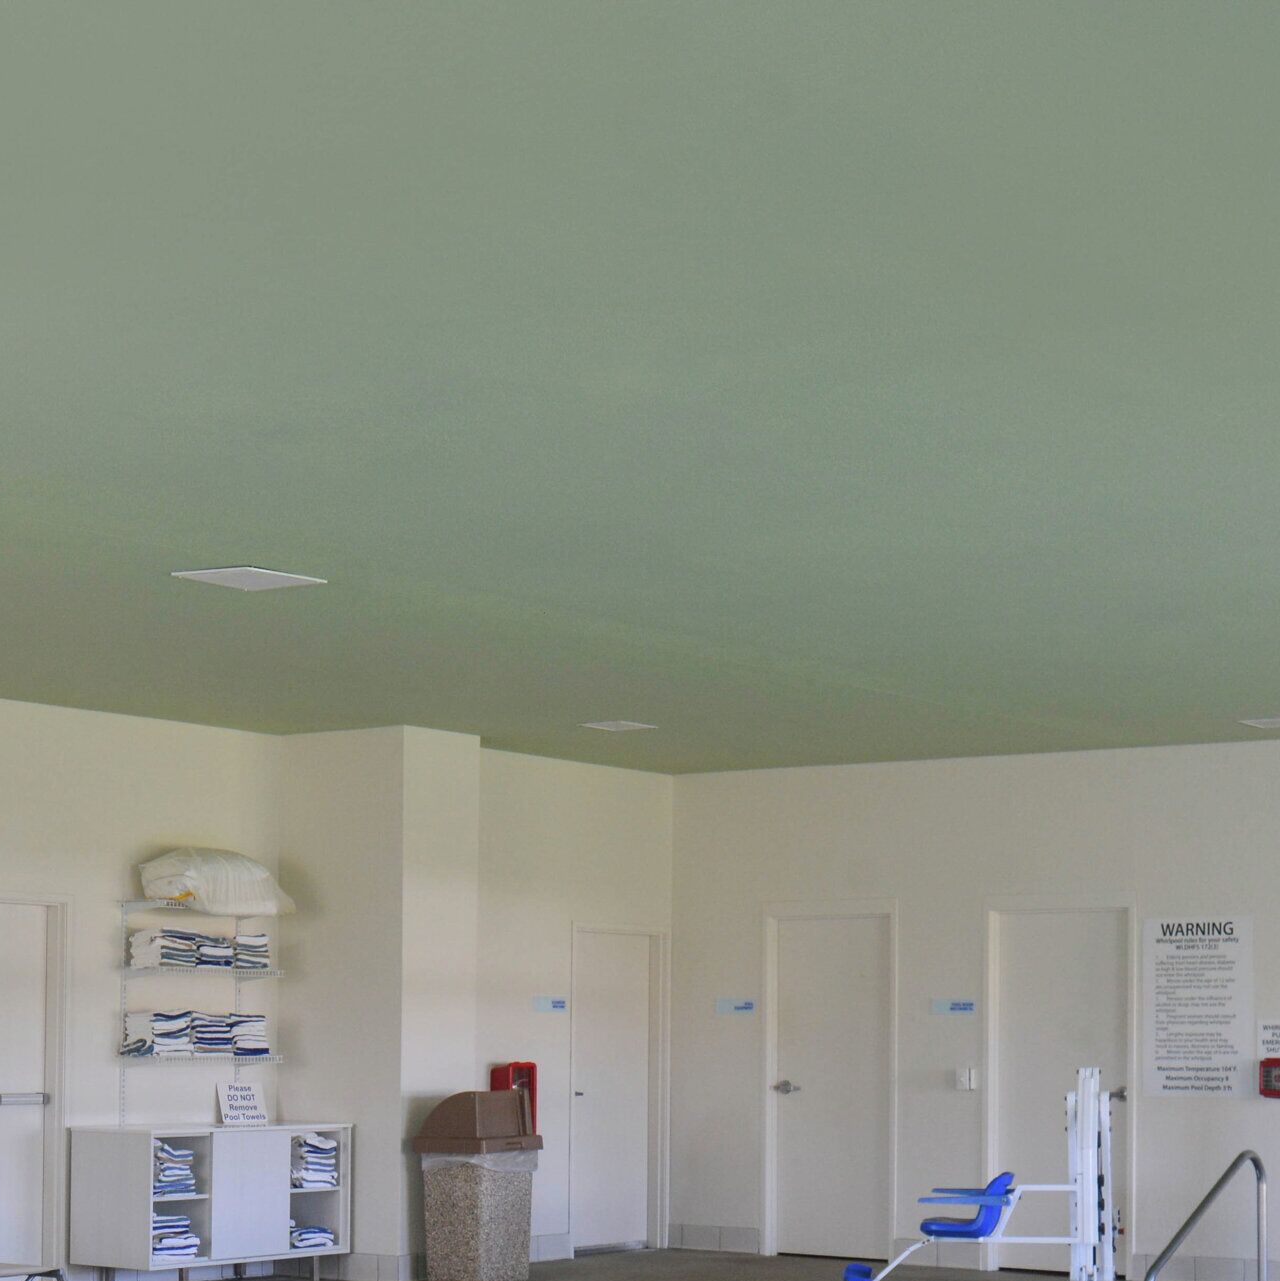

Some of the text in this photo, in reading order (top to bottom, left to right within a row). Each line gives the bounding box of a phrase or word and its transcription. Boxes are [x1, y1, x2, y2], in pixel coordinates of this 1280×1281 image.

[1161, 921, 1234, 937] WARNING
[1222, 936, 1239, 944] safety
[228, 1084, 252, 1092] Please
[227, 1094, 239, 1102] DO
[229, 1103, 258, 1111] Remove
[224, 1113, 240, 1121] Pool
